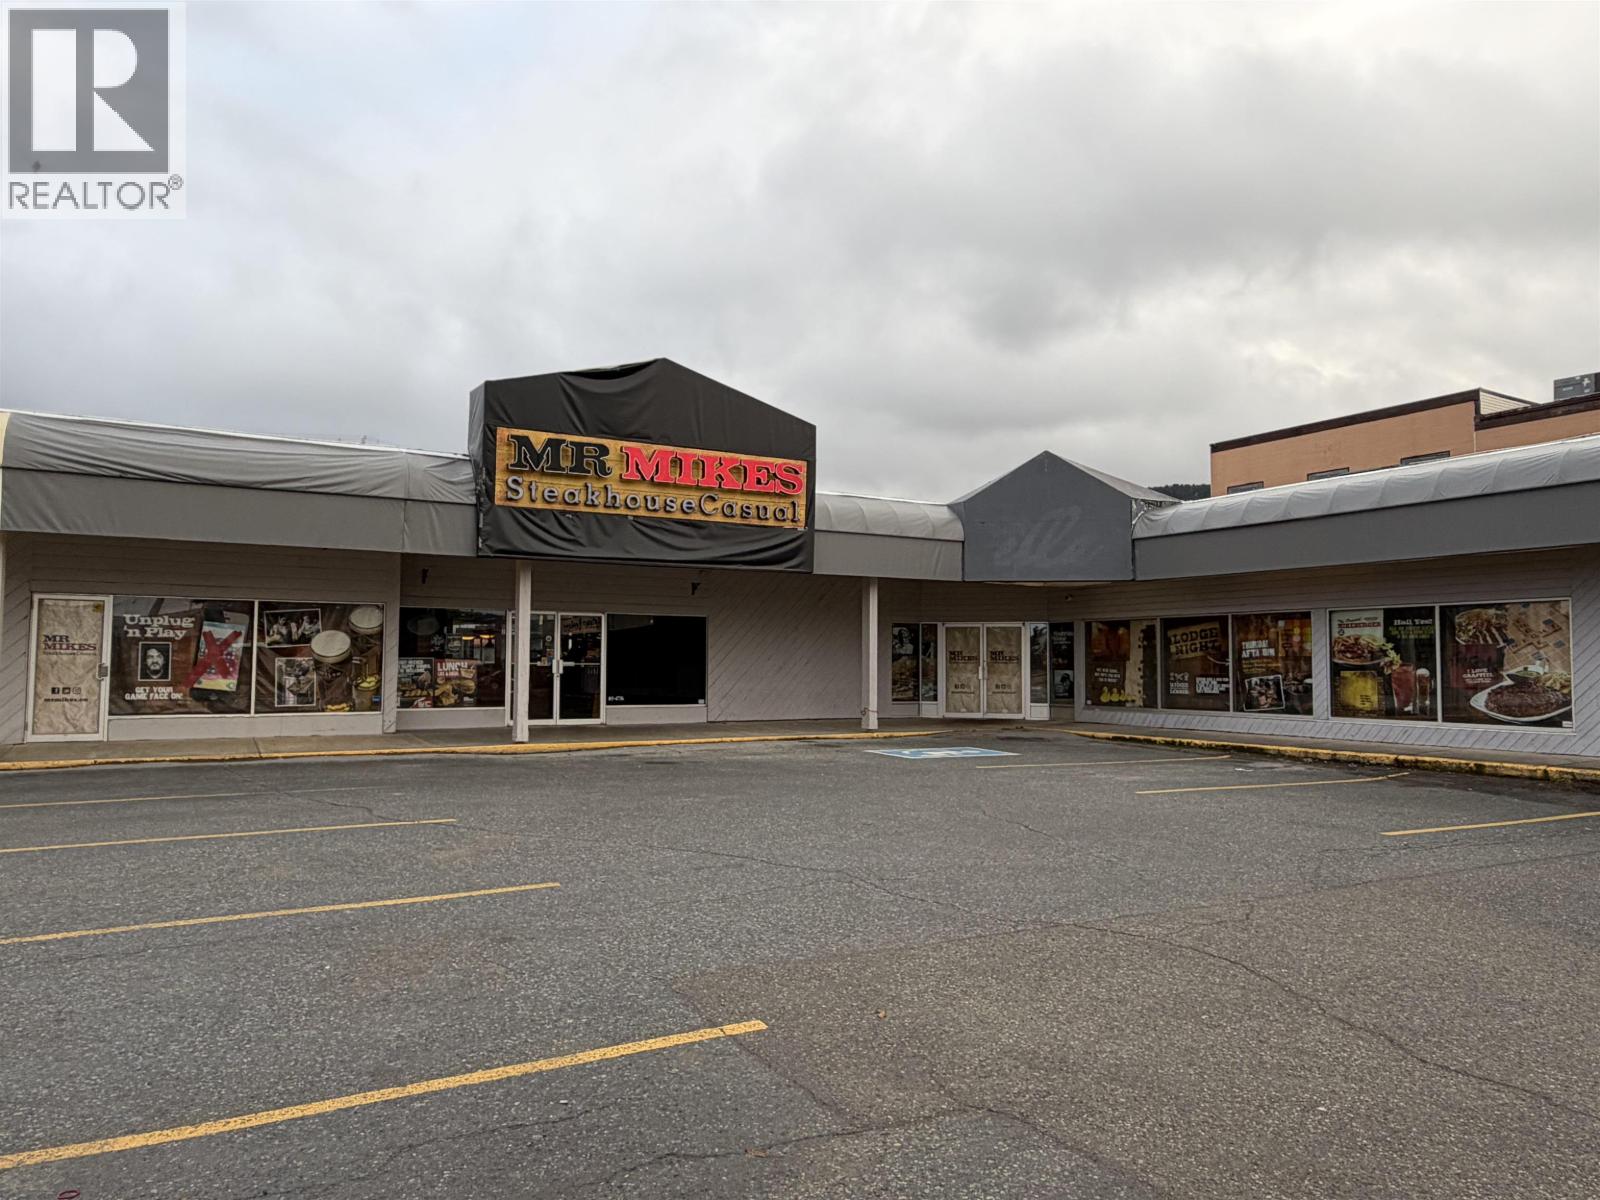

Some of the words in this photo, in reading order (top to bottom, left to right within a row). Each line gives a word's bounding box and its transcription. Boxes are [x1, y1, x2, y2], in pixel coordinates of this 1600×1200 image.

[507, 433, 613, 479] MR
[620, 445, 805, 496] MIKES
[123, 614, 196, 629] Unplug
[43, 634, 70, 643] MR
[144, 627, 188, 641] Play
[1170, 627, 1219, 645] LODGE
[43, 643, 97, 651] MIKES
[1174, 639, 1221, 656] NIGHT
[437, 661, 469, 672] LUNCH
[124, 693, 149, 701] GAME
[149, 692, 170, 700] FACE
